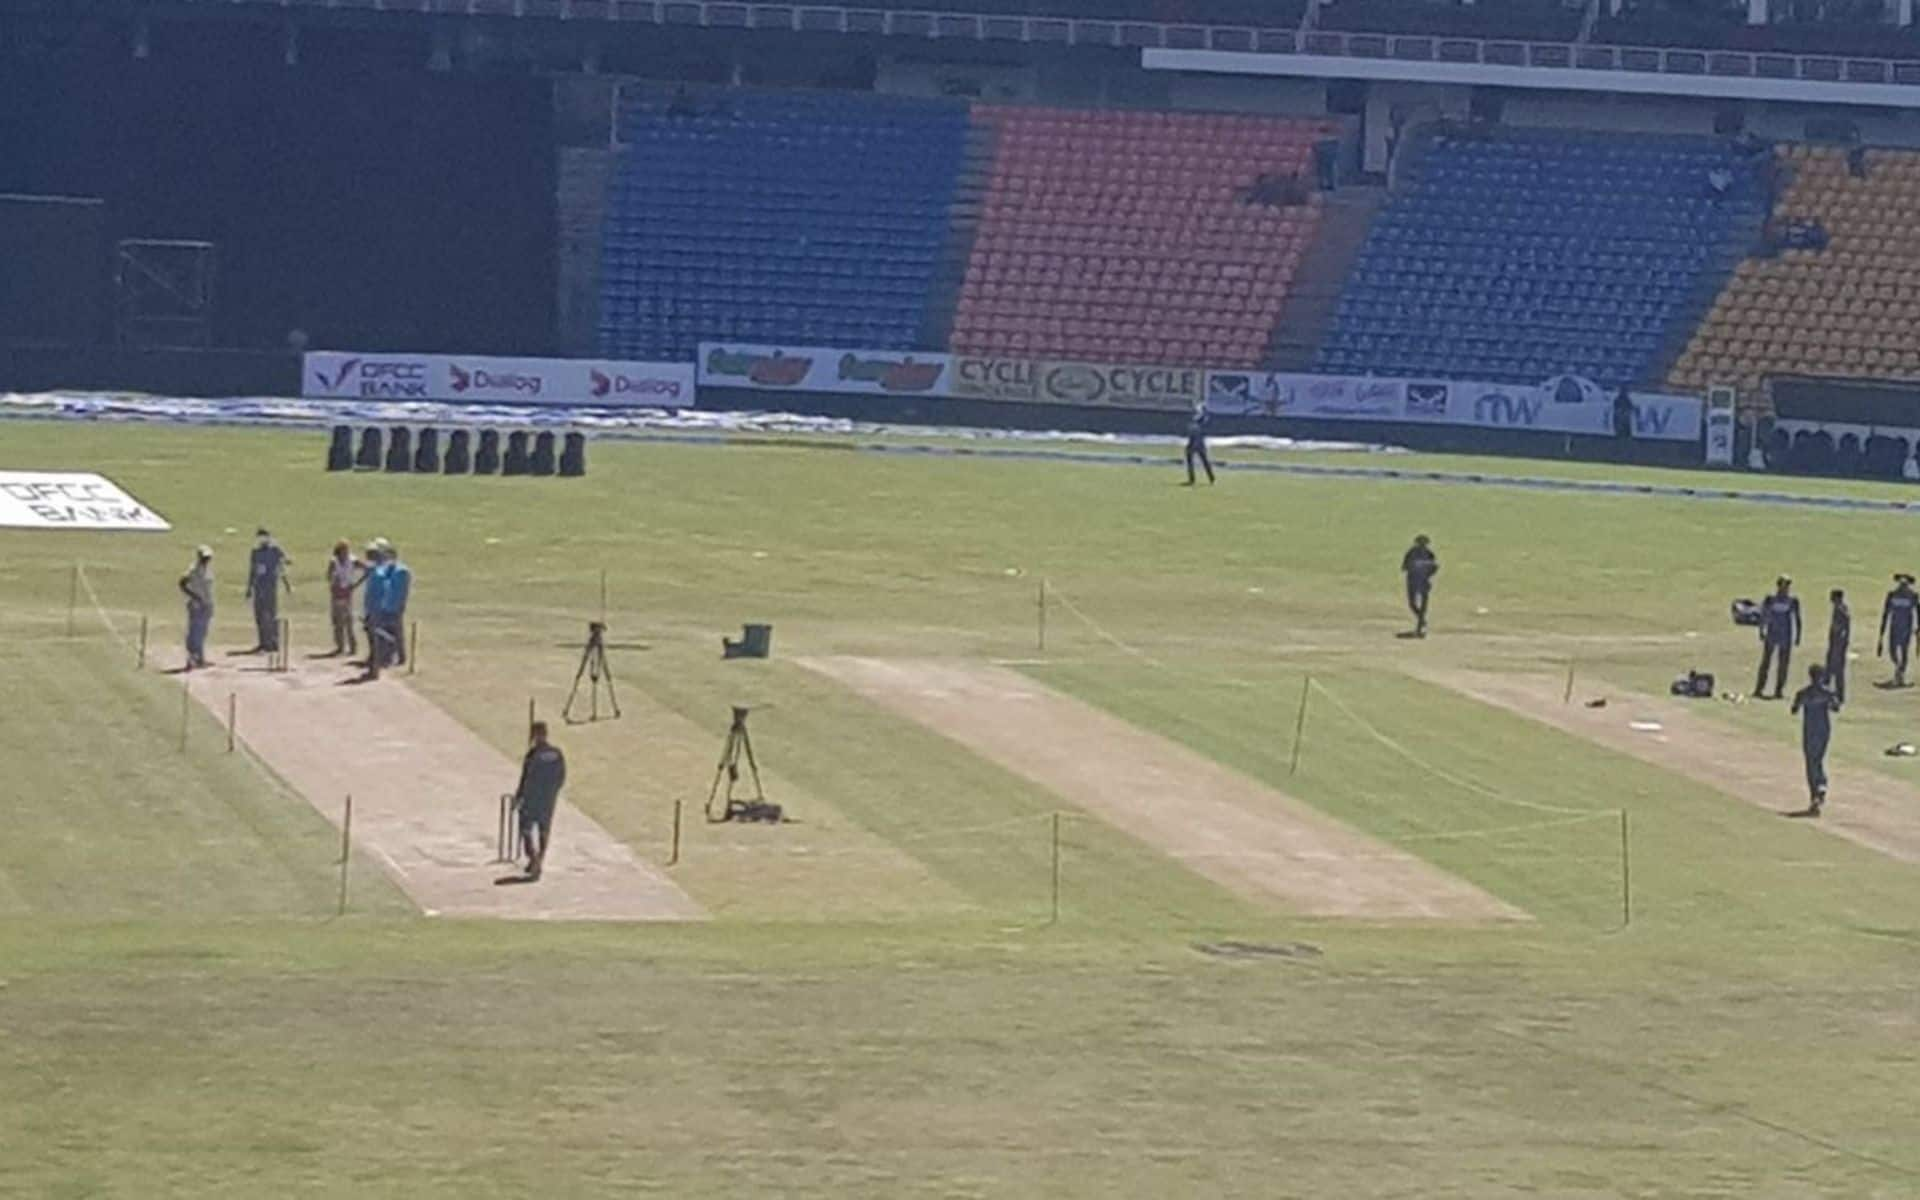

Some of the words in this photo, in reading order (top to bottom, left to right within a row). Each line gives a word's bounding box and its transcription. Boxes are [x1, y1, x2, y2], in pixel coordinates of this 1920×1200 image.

[361, 362, 427, 378] DFCC
[361, 381, 427, 397] BANK
[1109, 368, 1196, 394] CYCLE
[0, 482, 121, 502] DFCC
